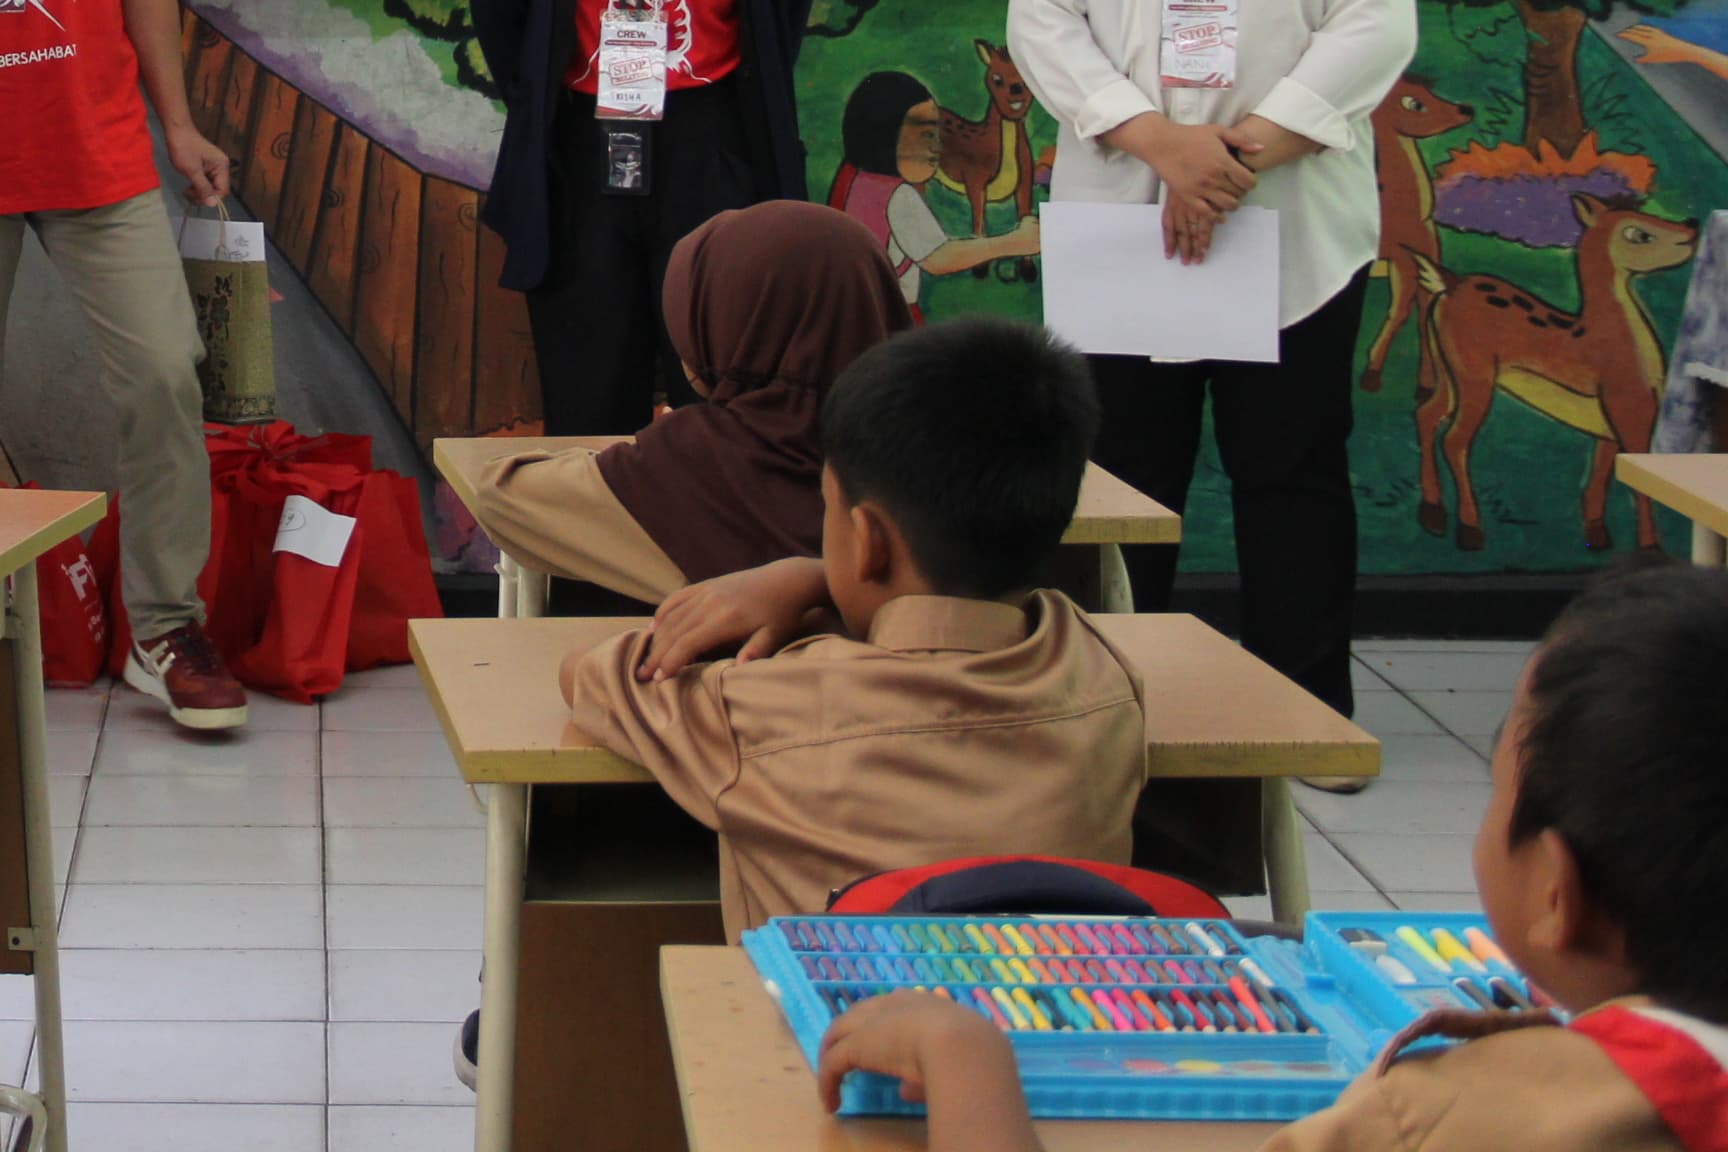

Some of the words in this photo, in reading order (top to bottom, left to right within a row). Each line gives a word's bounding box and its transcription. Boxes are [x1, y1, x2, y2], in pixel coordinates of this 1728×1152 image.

[617, 30, 646, 39] CREW
[1179, 25, 1215, 41] STOP
[614, 60, 647, 76] STOP
